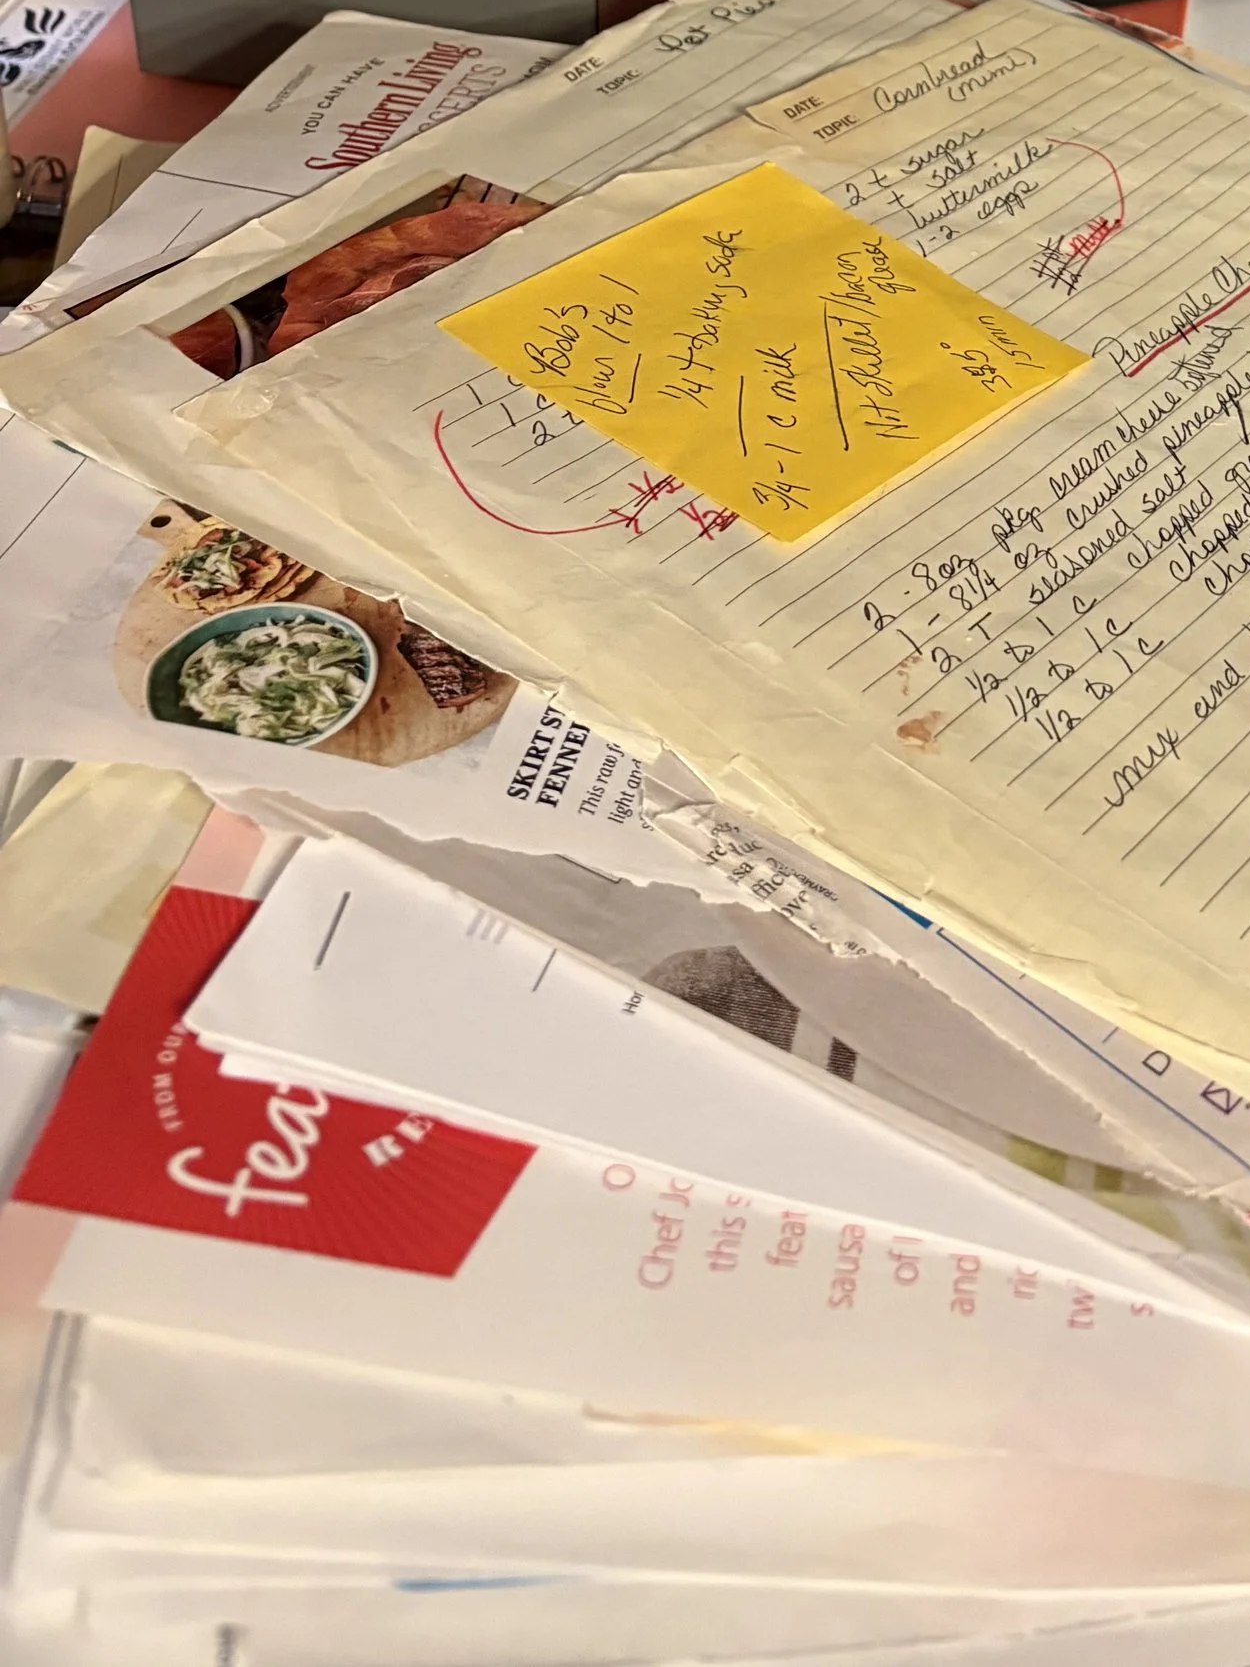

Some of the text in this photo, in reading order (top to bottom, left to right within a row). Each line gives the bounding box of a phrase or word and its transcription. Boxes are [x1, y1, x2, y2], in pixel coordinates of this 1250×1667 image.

[300, 56, 386, 136] YOU CAN HAVE
[304, 40, 482, 174] Southern Living
[873, 39, 1008, 114] Cornbread
[845, 127, 986, 207] 2 sugar
[906, 140, 1054, 230] buttermilk
[925, 149, 979, 189] salt
[976, 180, 1041, 221] eggs
[702, 228, 743, 279] soda
[523, 303, 589, 377] Bob's
[1092, 289, 1224, 378] Pineapple
[753, 342, 798, 403] milk
[531, 420, 557, 447] 2
[863, 600, 898, 632] 2
[1048, 437, 1116, 502] cream
[1118, 387, 1184, 444] cheese
[1065, 449, 1149, 531] crushed
[931, 646, 963, 673] 2
[1029, 508, 1135, 606] seasoned
[1141, 464, 1189, 515] salt
[965, 669, 1009, 703] 1/2
[1003, 639, 1036, 664] to
[1126, 478, 1215, 570] chopped
[1004, 685, 1048, 723] 1/2
[1048, 658, 1075, 683] to
[1035, 708, 1083, 743] 1/2
[1084, 678, 1114, 700] to
[506, 729, 555, 802] SKIRT
[1103, 725, 1182, 809] mix
[1193, 658, 1246, 720] and
[577, 754, 619, 817] This raw
[607, 790, 635, 825] light
[152, 1071, 184, 1133] FROM
[637, 1210, 686, 1290] Chef
[705, 1214, 749, 1274] this
[886, 1245, 921, 1287] of
[950, 1253, 982, 1317] and
